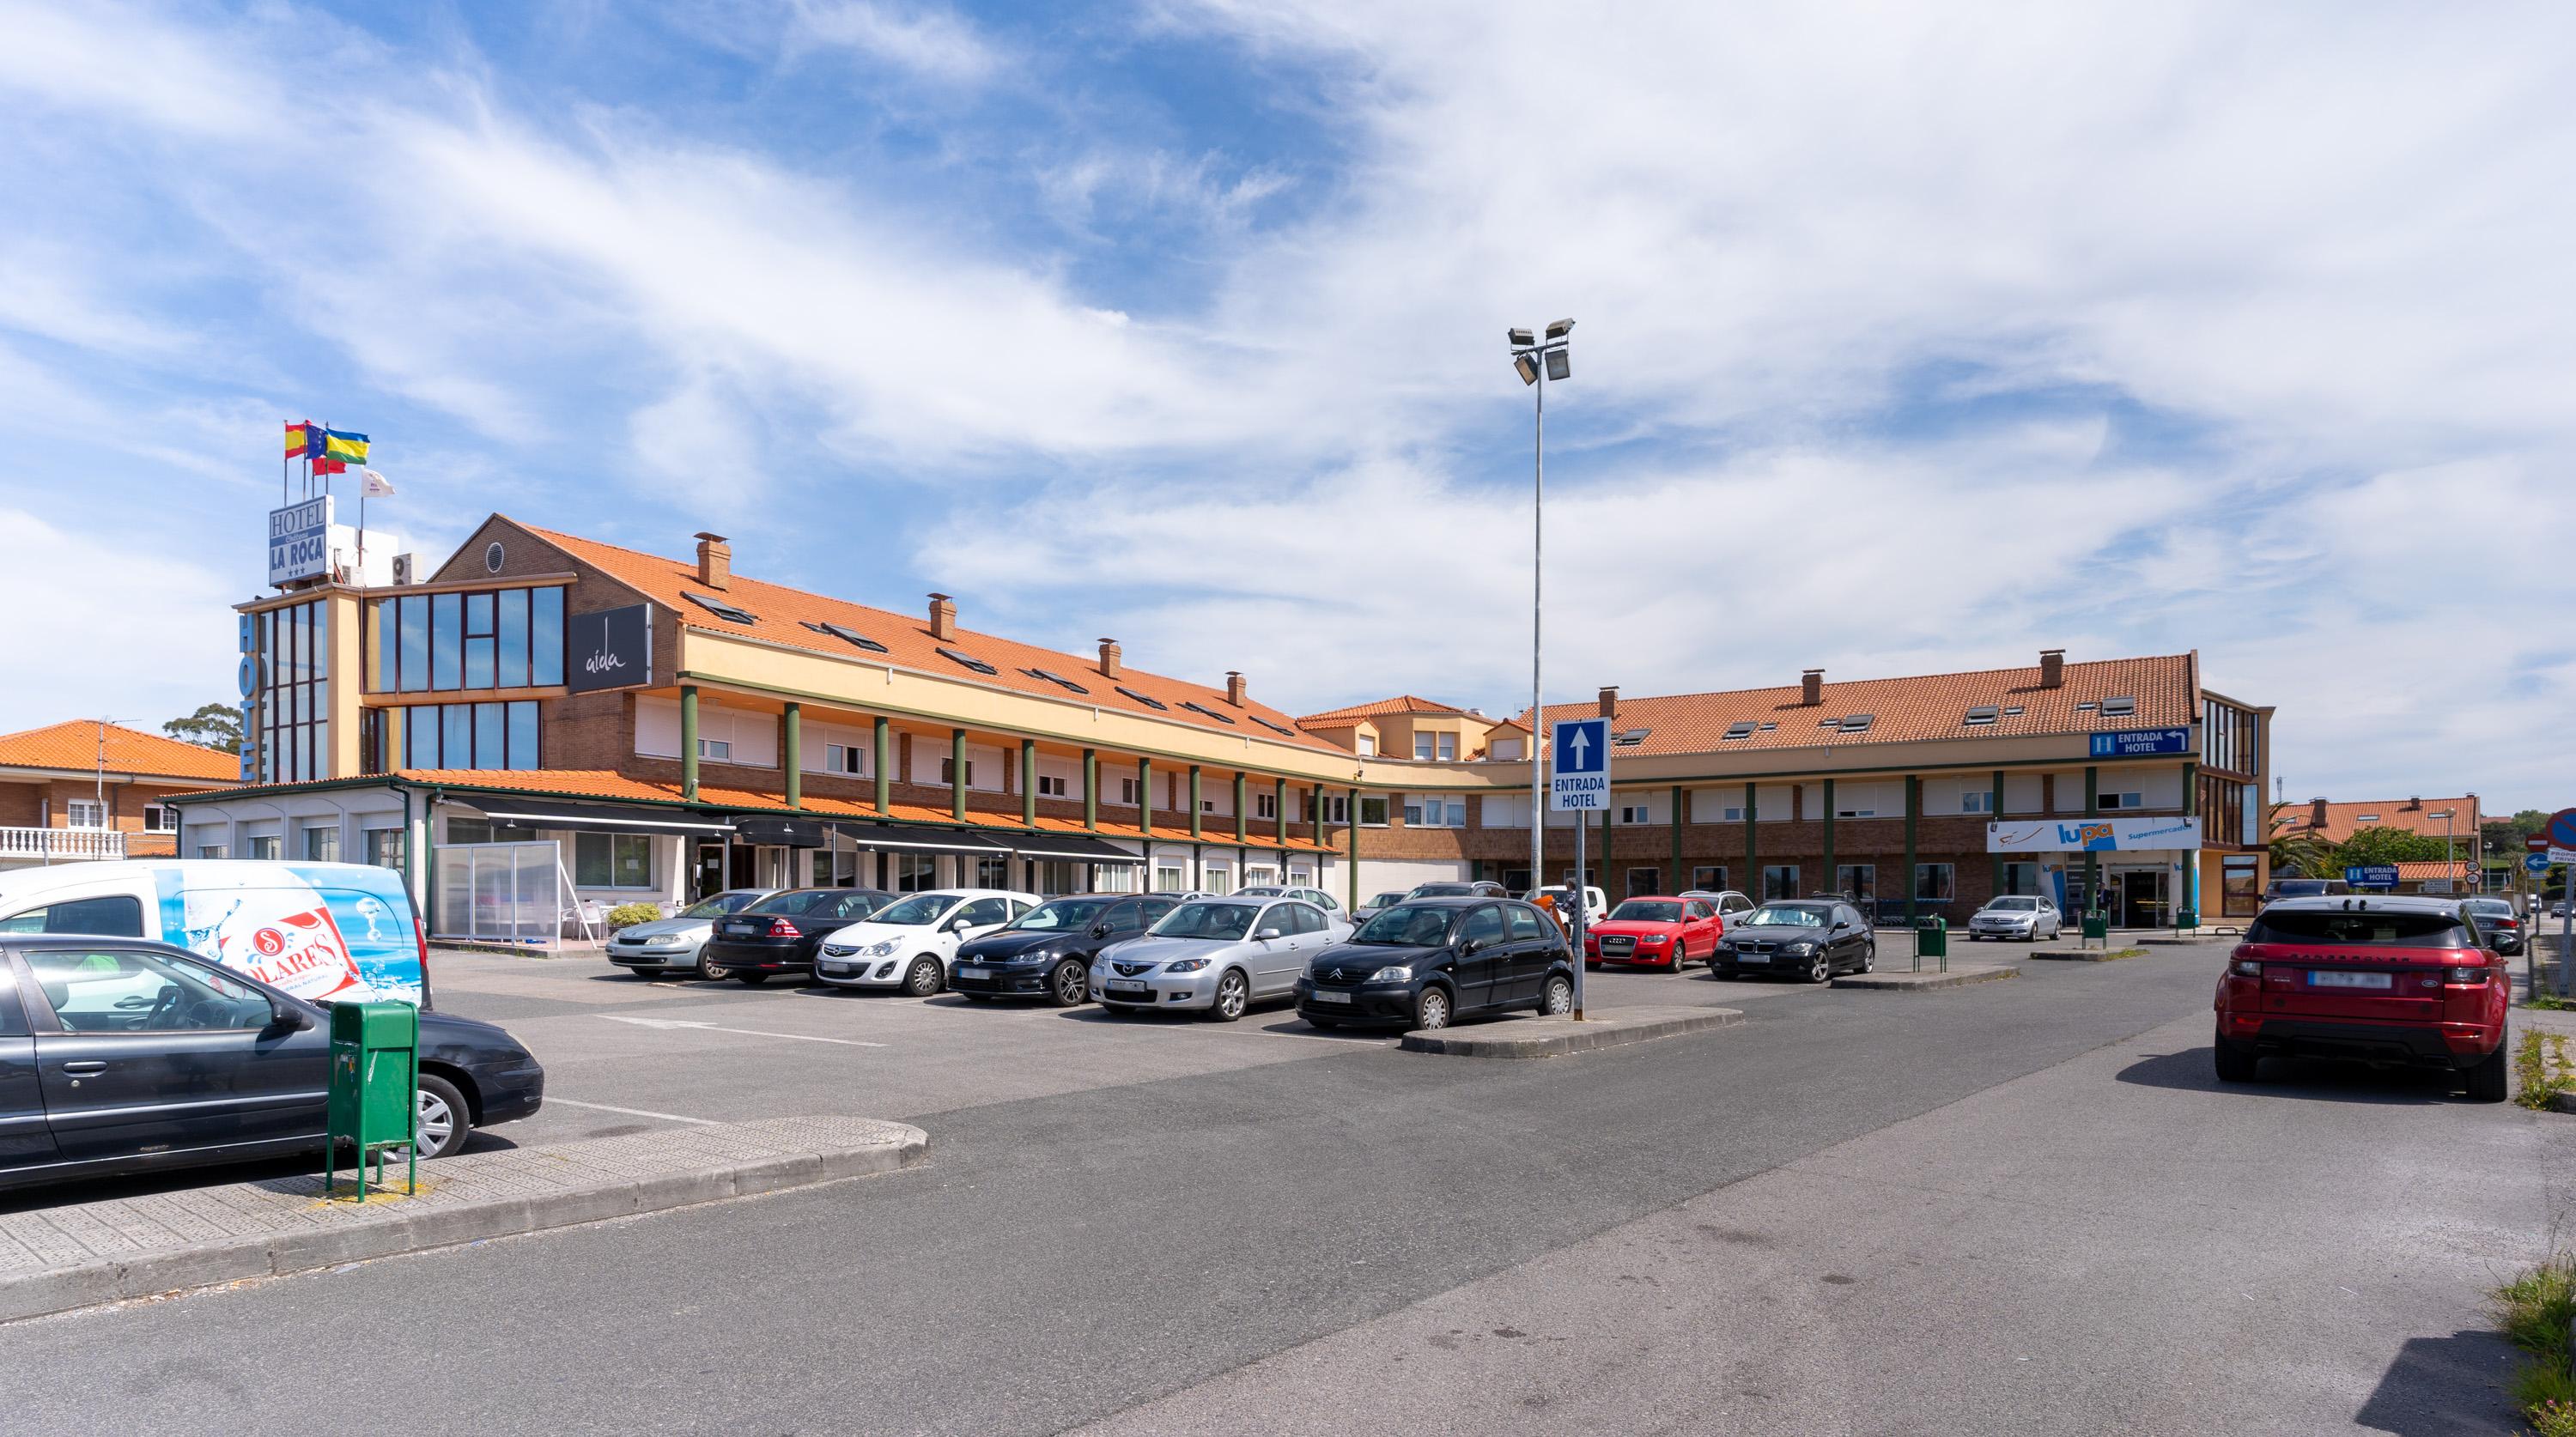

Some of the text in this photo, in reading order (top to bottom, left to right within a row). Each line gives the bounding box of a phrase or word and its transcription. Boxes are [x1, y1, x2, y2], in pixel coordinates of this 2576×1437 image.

[271, 503, 324, 537] HOTEL
[271, 537, 324, 571] LA ROCA
[239, 612, 256, 781] HOTE
[2117, 732, 2163, 743] ENTRADA
[2125, 743, 2156, 753] HOTEL
[1555, 777, 1605, 791] ENTRADA
[1563, 793, 1597, 807] HOTEL
[2057, 823, 2114, 846] lupa
